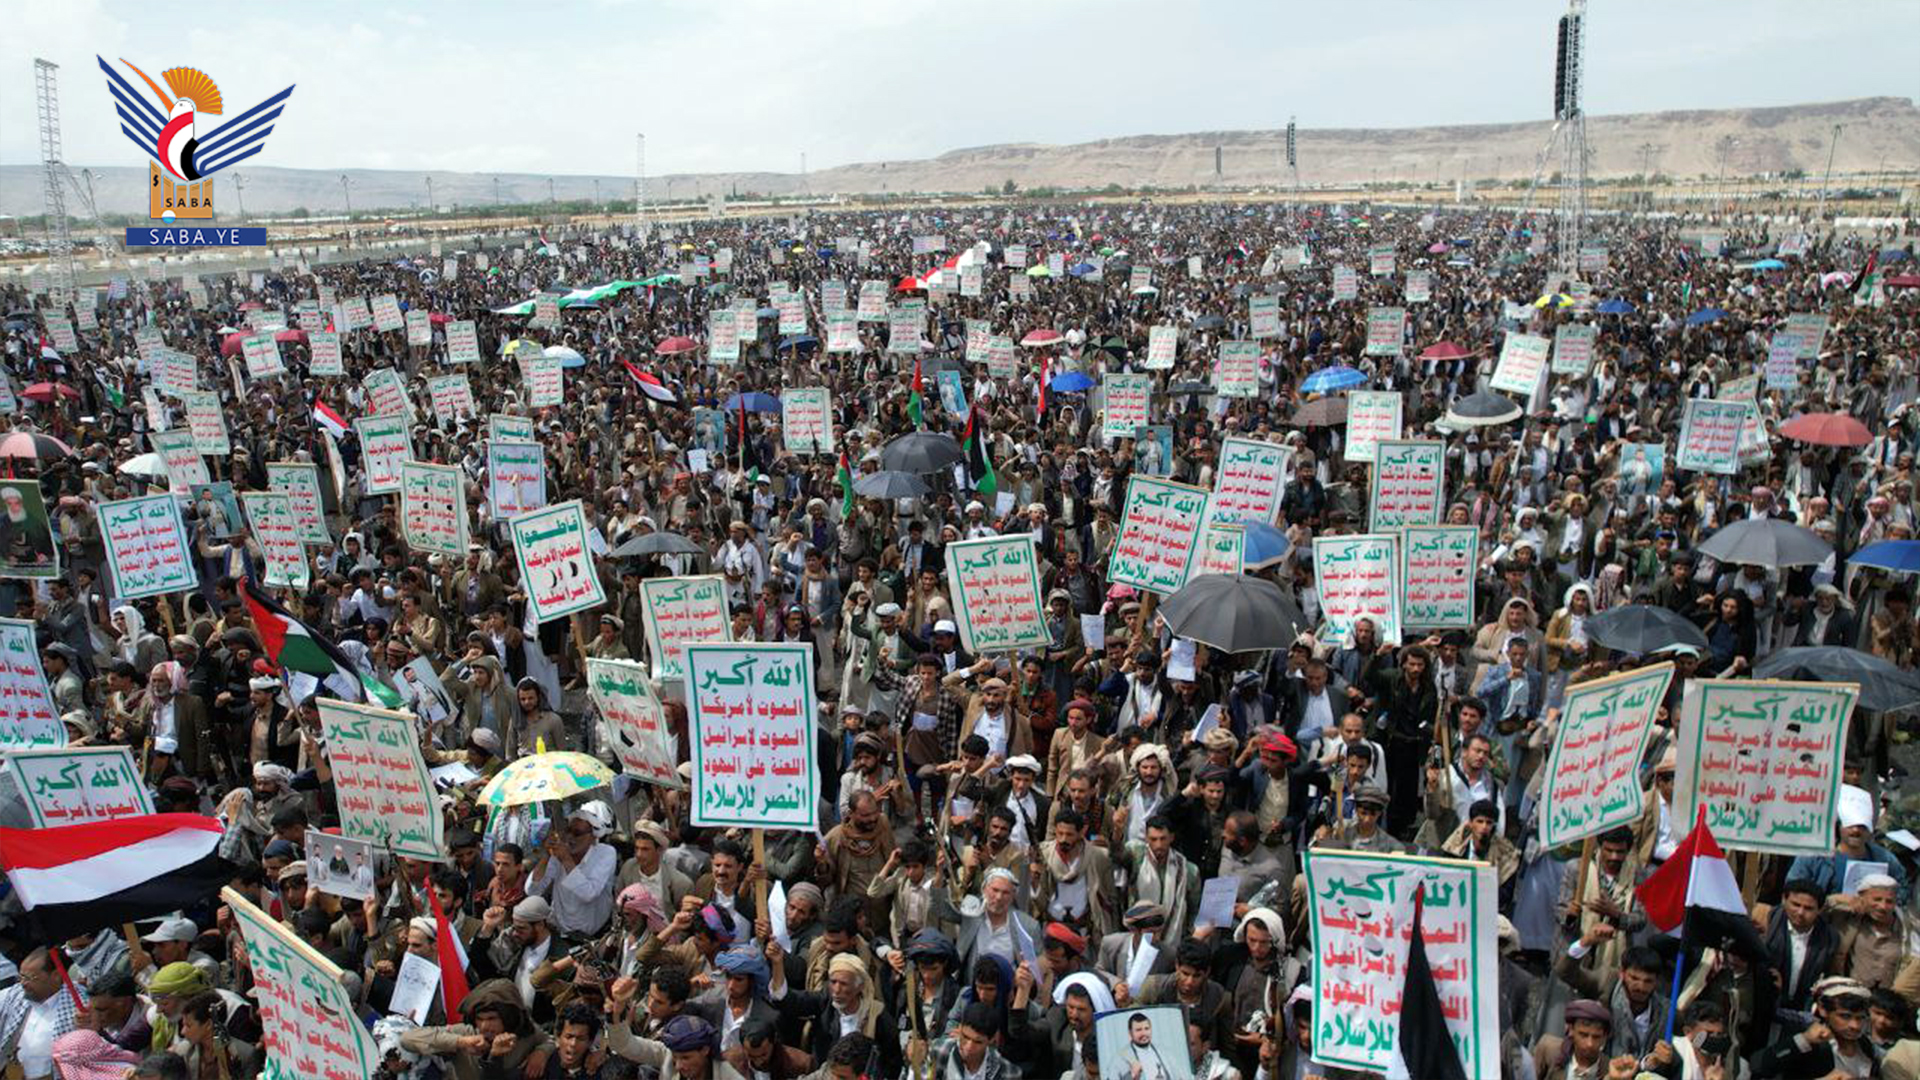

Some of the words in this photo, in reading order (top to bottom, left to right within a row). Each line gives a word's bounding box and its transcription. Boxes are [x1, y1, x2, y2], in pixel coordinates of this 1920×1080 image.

[1227, 448, 1262, 466] أكبر
[1260, 451, 1280, 465] الله
[1382, 447, 1416, 468] أكبر
[1417, 450, 1438, 464] الله
[1132, 489, 1175, 507] أكبر
[1174, 495, 1201, 513] الله
[111, 503, 144, 528] أكبر
[149, 503, 172, 517] الله
[519, 515, 578, 548] قاطعوا
[1165, 519, 1196, 532] الموت
[1215, 534, 1238, 552] الله
[1364, 544, 1389, 561] الله
[1412, 532, 1448, 555] أكبر
[1450, 535, 1472, 550] الله
[961, 546, 998, 574] أكبر
[1003, 547, 1028, 564] الله
[1322, 544, 1361, 567] أكبر
[1001, 572, 1031, 586] الموت
[1150, 570, 1181, 586] النصر
[655, 583, 689, 607] أكبر
[693, 584, 719, 601] الله
[9, 632, 31, 652] الله
[700, 654, 758, 693] أكبر
[763, 658, 801, 686] الله
[701, 694, 752, 718] لأمريكا
[1622, 686, 1657, 708] الله
[758, 698, 802, 720] الموت
[1571, 688, 1624, 730] أكبر
[1710, 694, 1788, 724] أكبر
[1790, 698, 1838, 723] الله
[327, 716, 370, 744] أكبر
[378, 724, 409, 746] الله
[759, 728, 804, 749] الموت
[1705, 726, 1772, 748] لأمريكا
[1777, 734, 1831, 752] الموت
[379, 755, 416, 770] الموت
[704, 756, 741, 777] اليهود
[746, 759, 765, 778] على
[771, 757, 805, 775] اللعنة
[1774, 763, 1828, 780] الموت
[34, 758, 82, 798] أكبر
[91, 762, 130, 788] الله
[384, 779, 423, 794] الموت
[1699, 779, 1745, 798] اليهود
[1751, 785, 1776, 804] على
[1784, 785, 1825, 804] اللعنة
[95, 797, 142, 819] الموت
[377, 799, 396, 816] على
[705, 783, 755, 816] للإسلام
[761, 783, 806, 816] النصر
[1709, 803, 1759, 836] للإسلا
[1765, 810, 1822, 837] النصر
[396, 820, 429, 844] النصر
[1320, 865, 1404, 905] أكبر
[1321, 905, 1393, 938] لأمريكا
[1323, 982, 1374, 1009] اليهود
[307, 1031, 359, 1063] الموت
[1321, 1013, 1394, 1060] للإسلام
